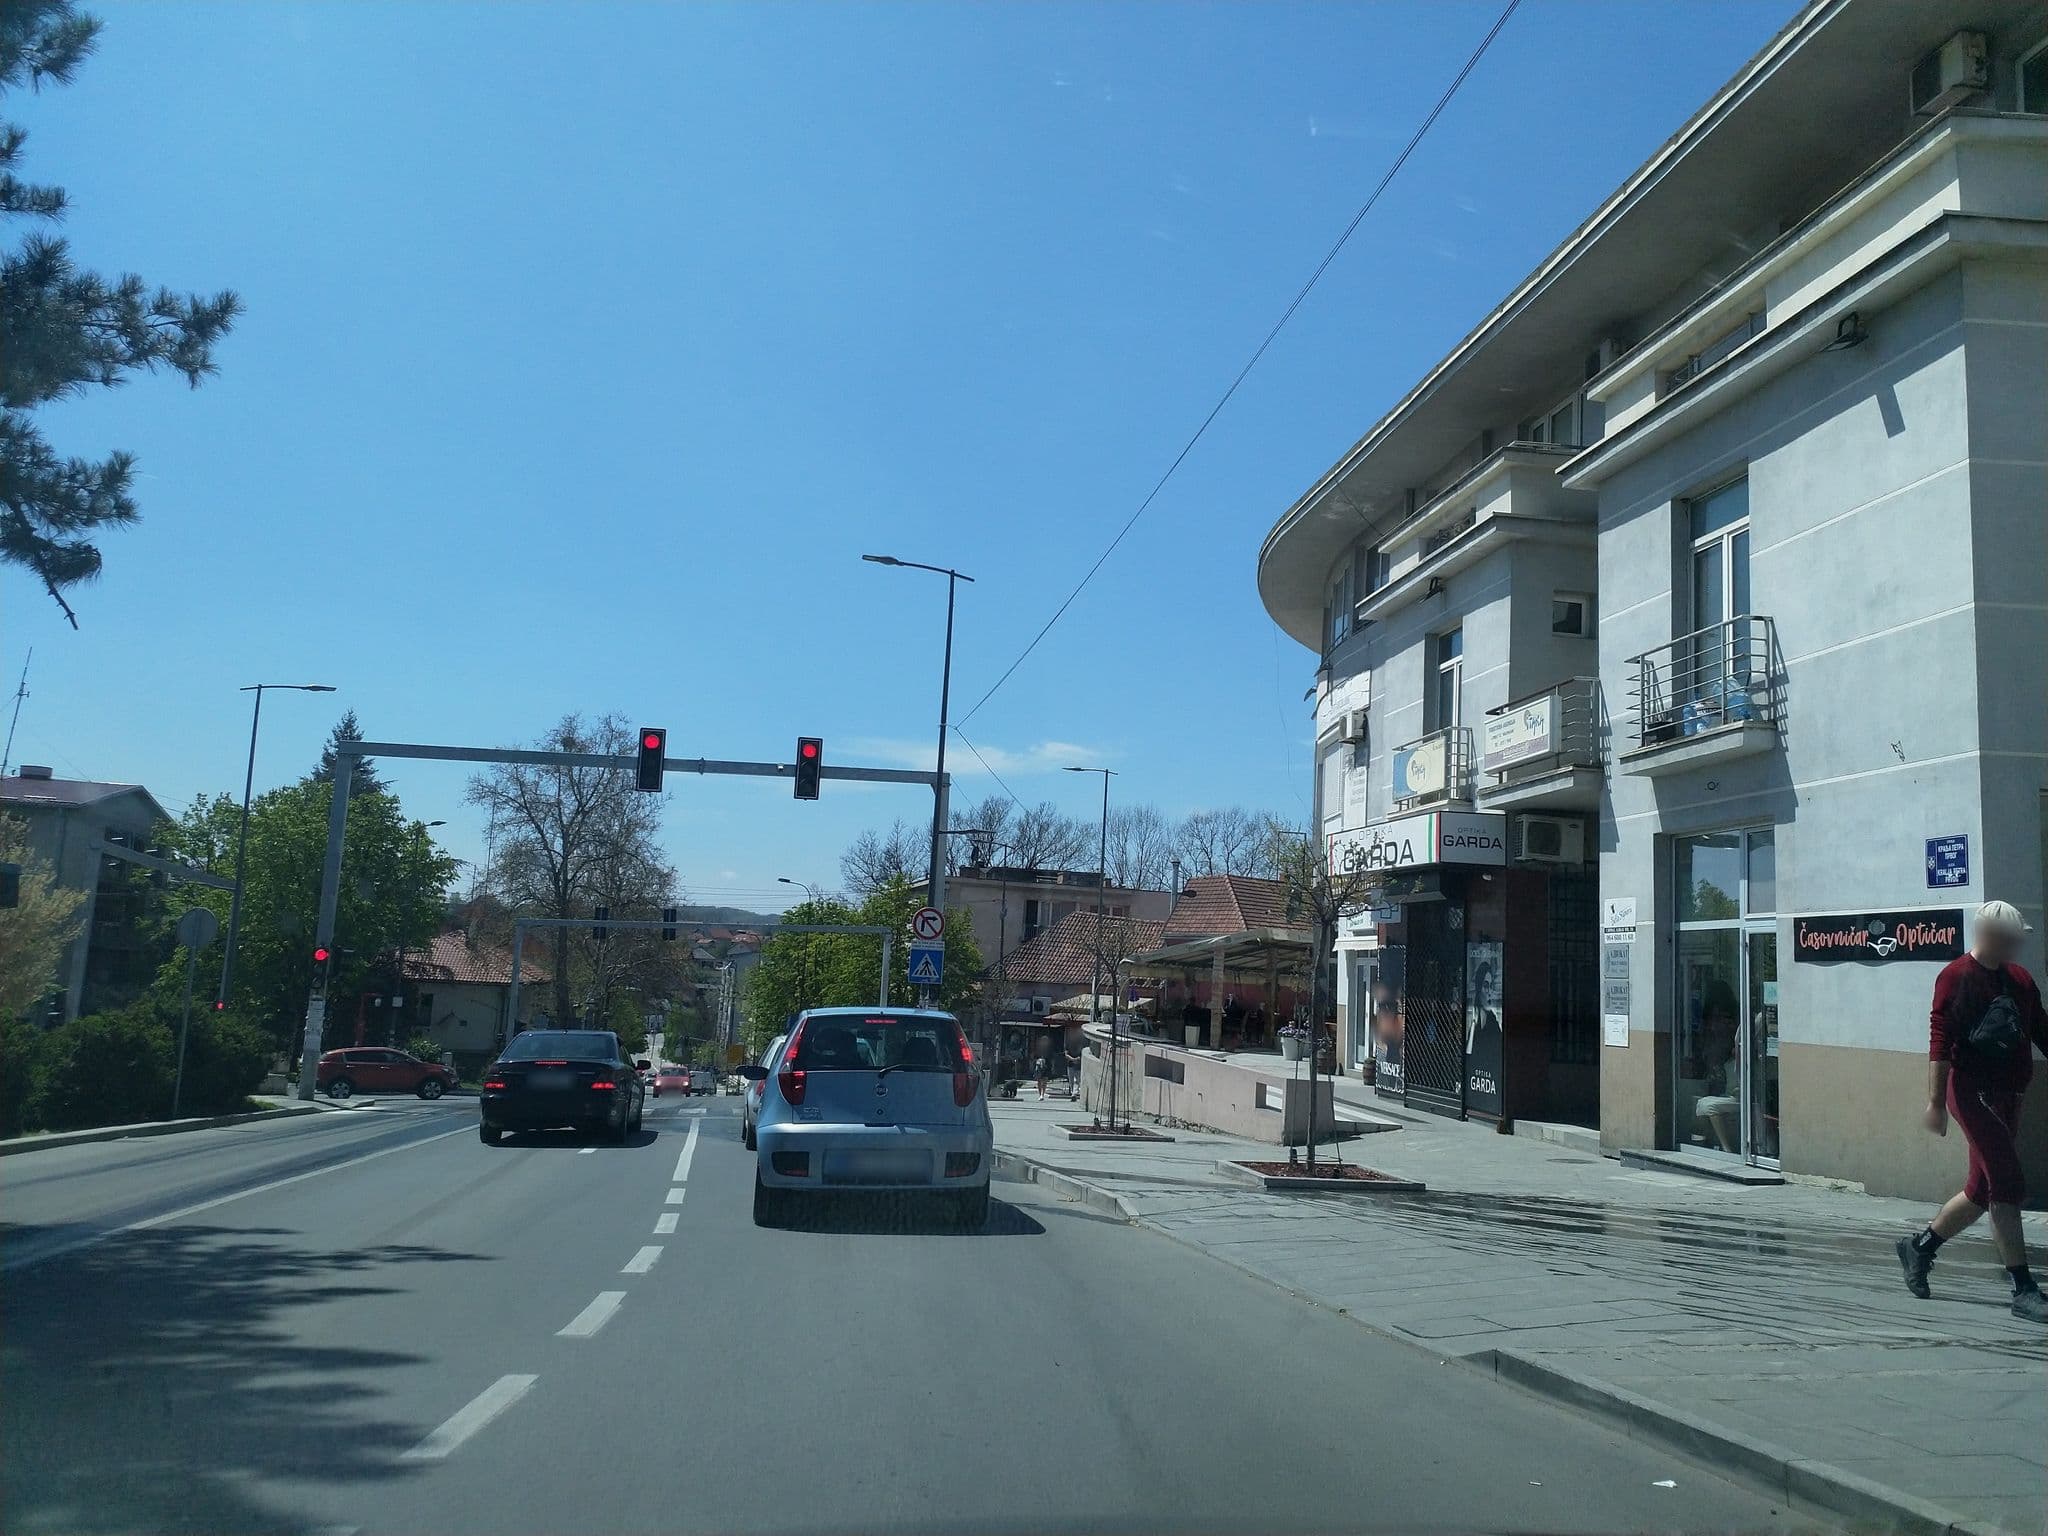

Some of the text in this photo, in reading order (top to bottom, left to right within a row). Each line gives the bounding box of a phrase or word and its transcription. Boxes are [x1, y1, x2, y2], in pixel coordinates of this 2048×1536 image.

[1443, 834, 1503, 850] GARDA
[1344, 838, 1415, 872] GARDA
[1800, 922, 1956, 951] Časovničar Optičar
[1470, 1076, 1497, 1095] GARDA
